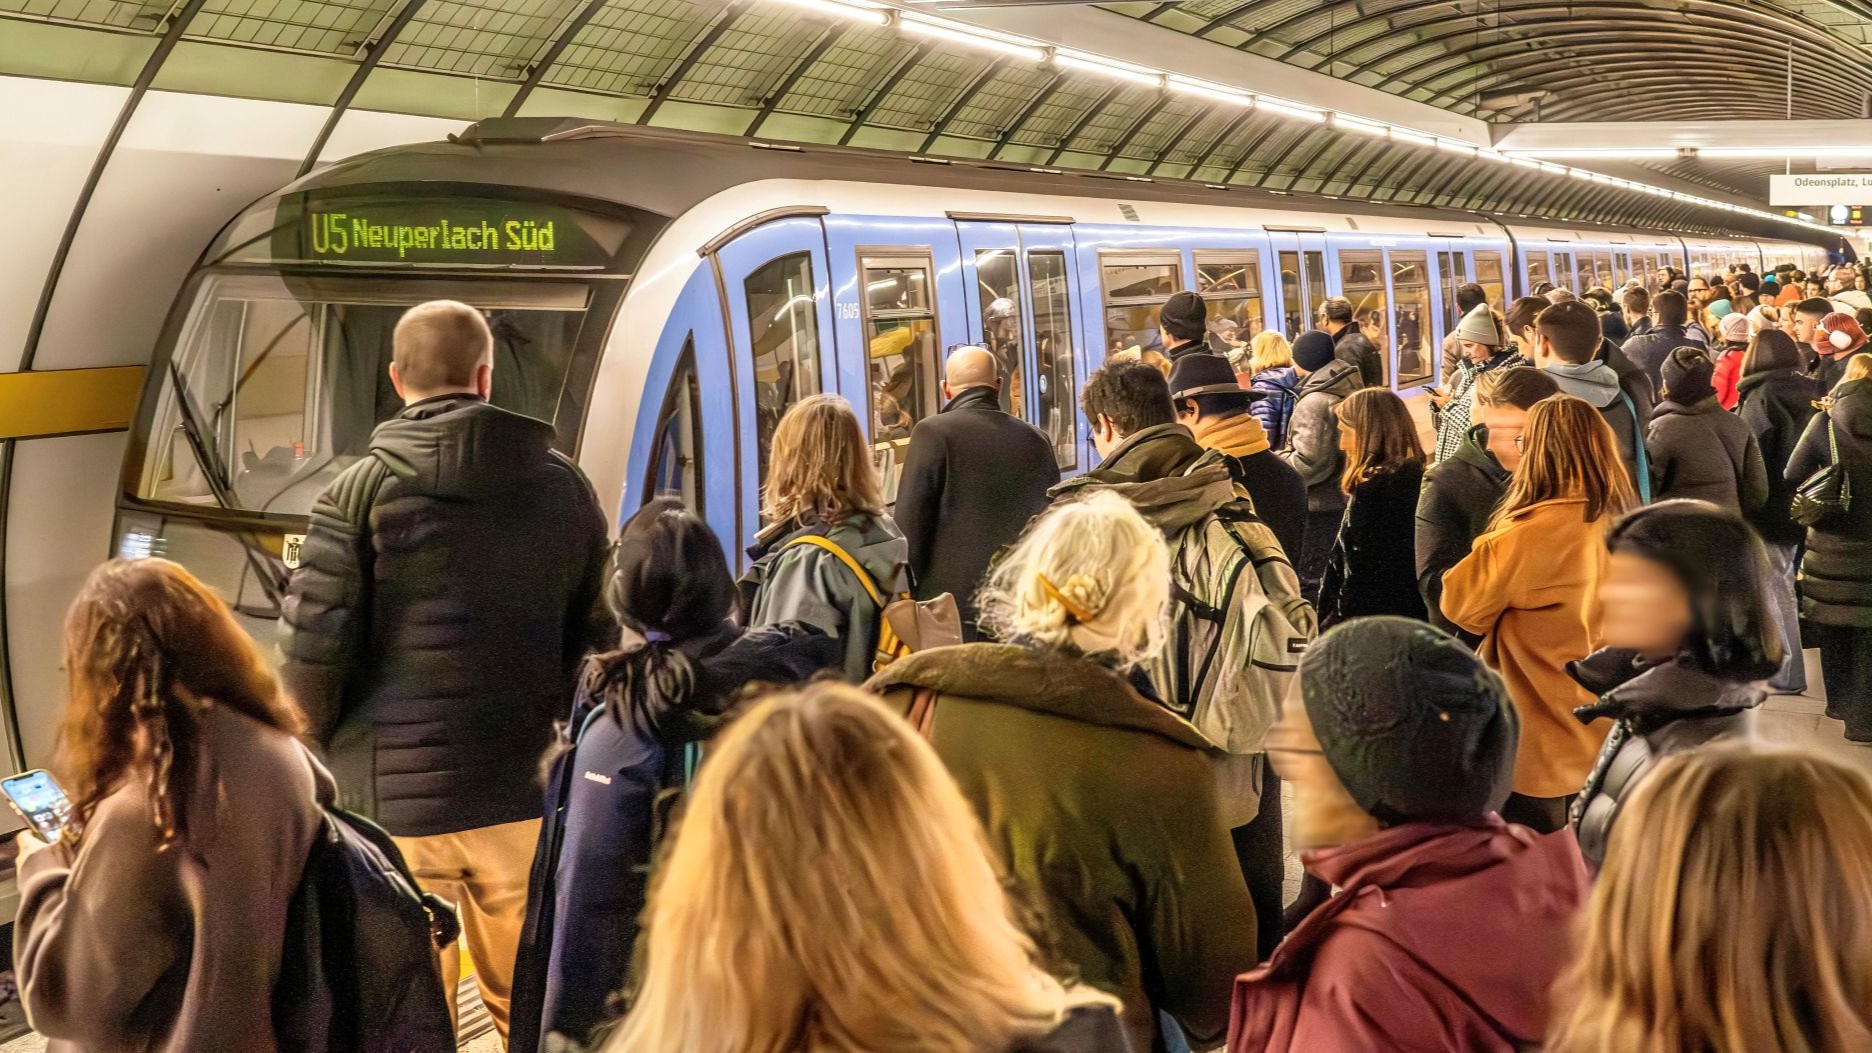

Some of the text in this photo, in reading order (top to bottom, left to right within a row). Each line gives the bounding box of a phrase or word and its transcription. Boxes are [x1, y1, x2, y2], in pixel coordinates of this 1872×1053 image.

[1794, 177, 1858, 188] Odeonsplatz,
[312, 213, 554, 258] U5 Neuperlach Süd
[837, 302, 859, 319] 7605
